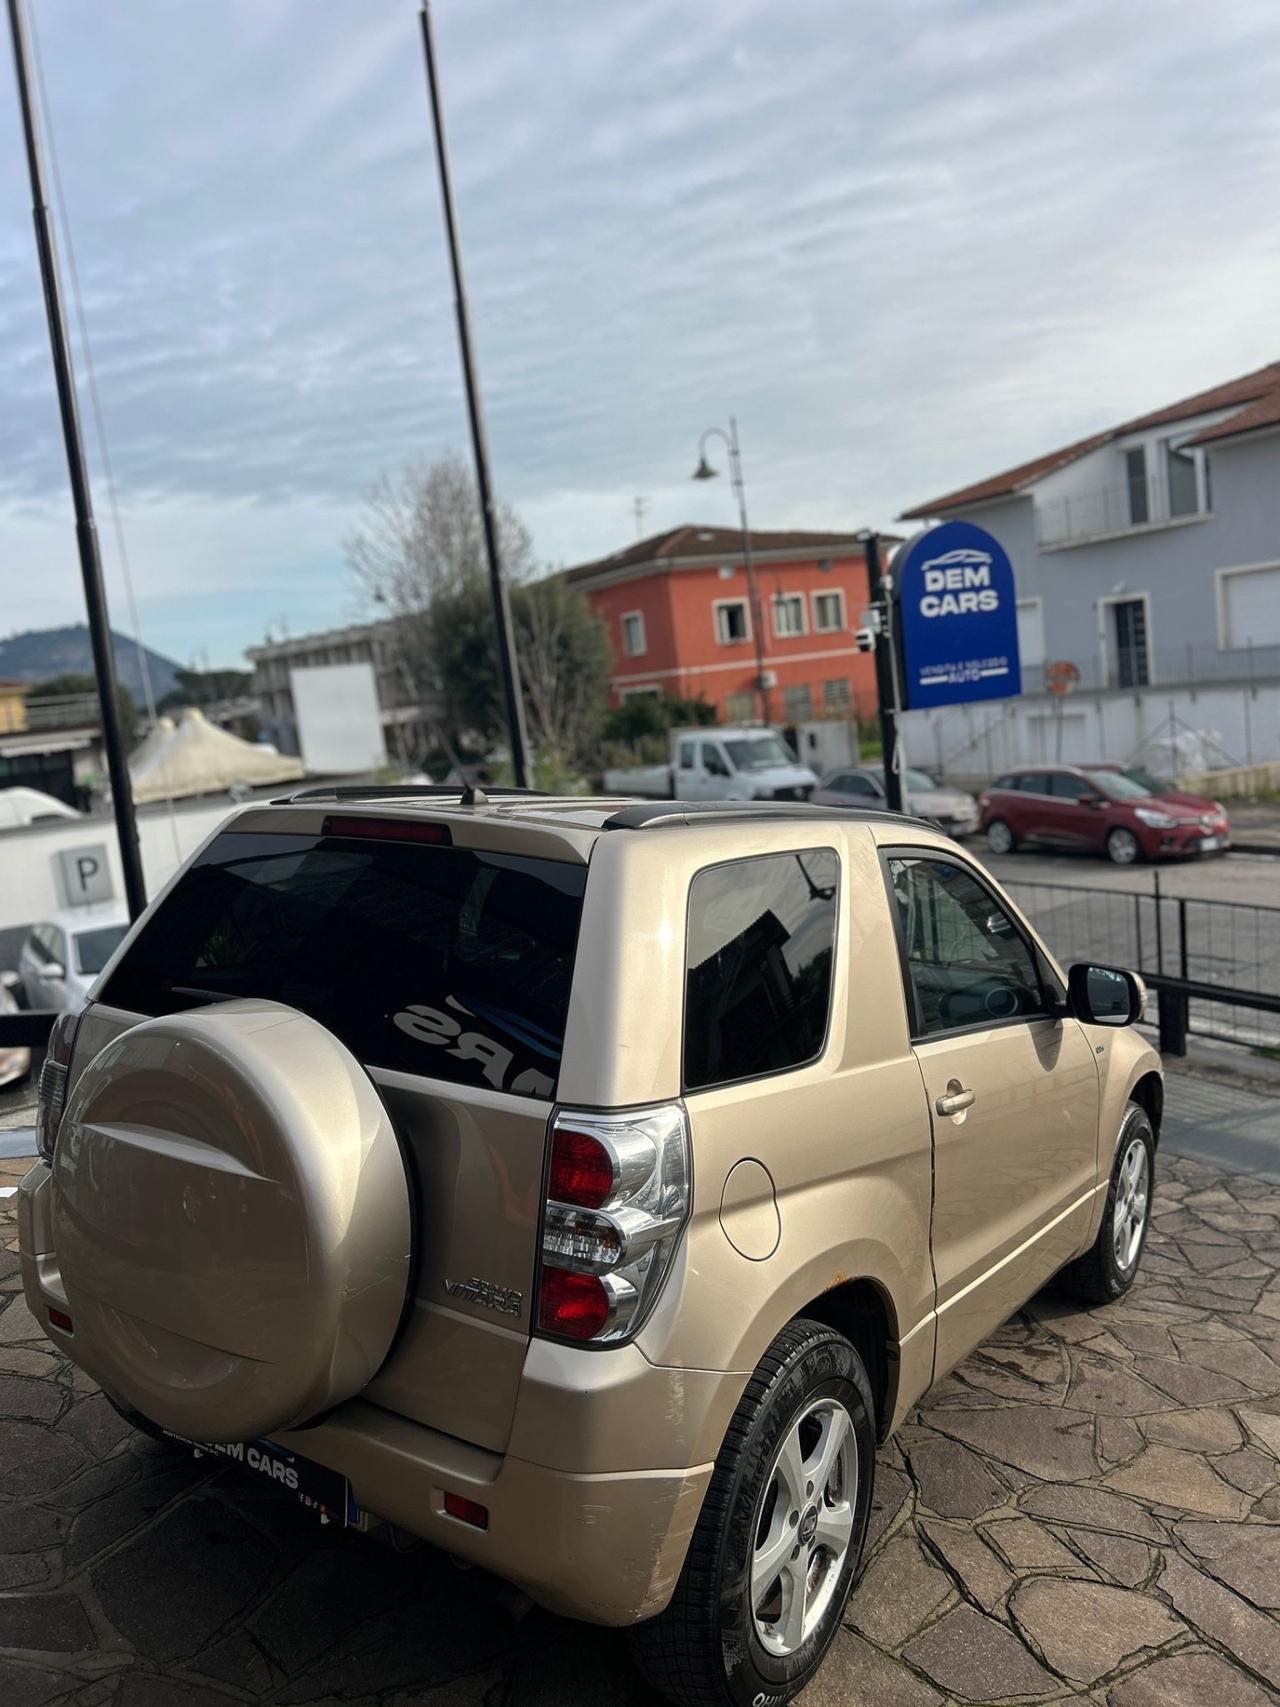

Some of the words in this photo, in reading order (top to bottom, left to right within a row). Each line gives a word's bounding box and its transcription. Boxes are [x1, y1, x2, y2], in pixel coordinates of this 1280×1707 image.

[924, 565, 990, 592] DEM
[919, 589, 999, 618] CARS
[77, 856, 98, 892] P
[247, 1448, 299, 1489] CARS
